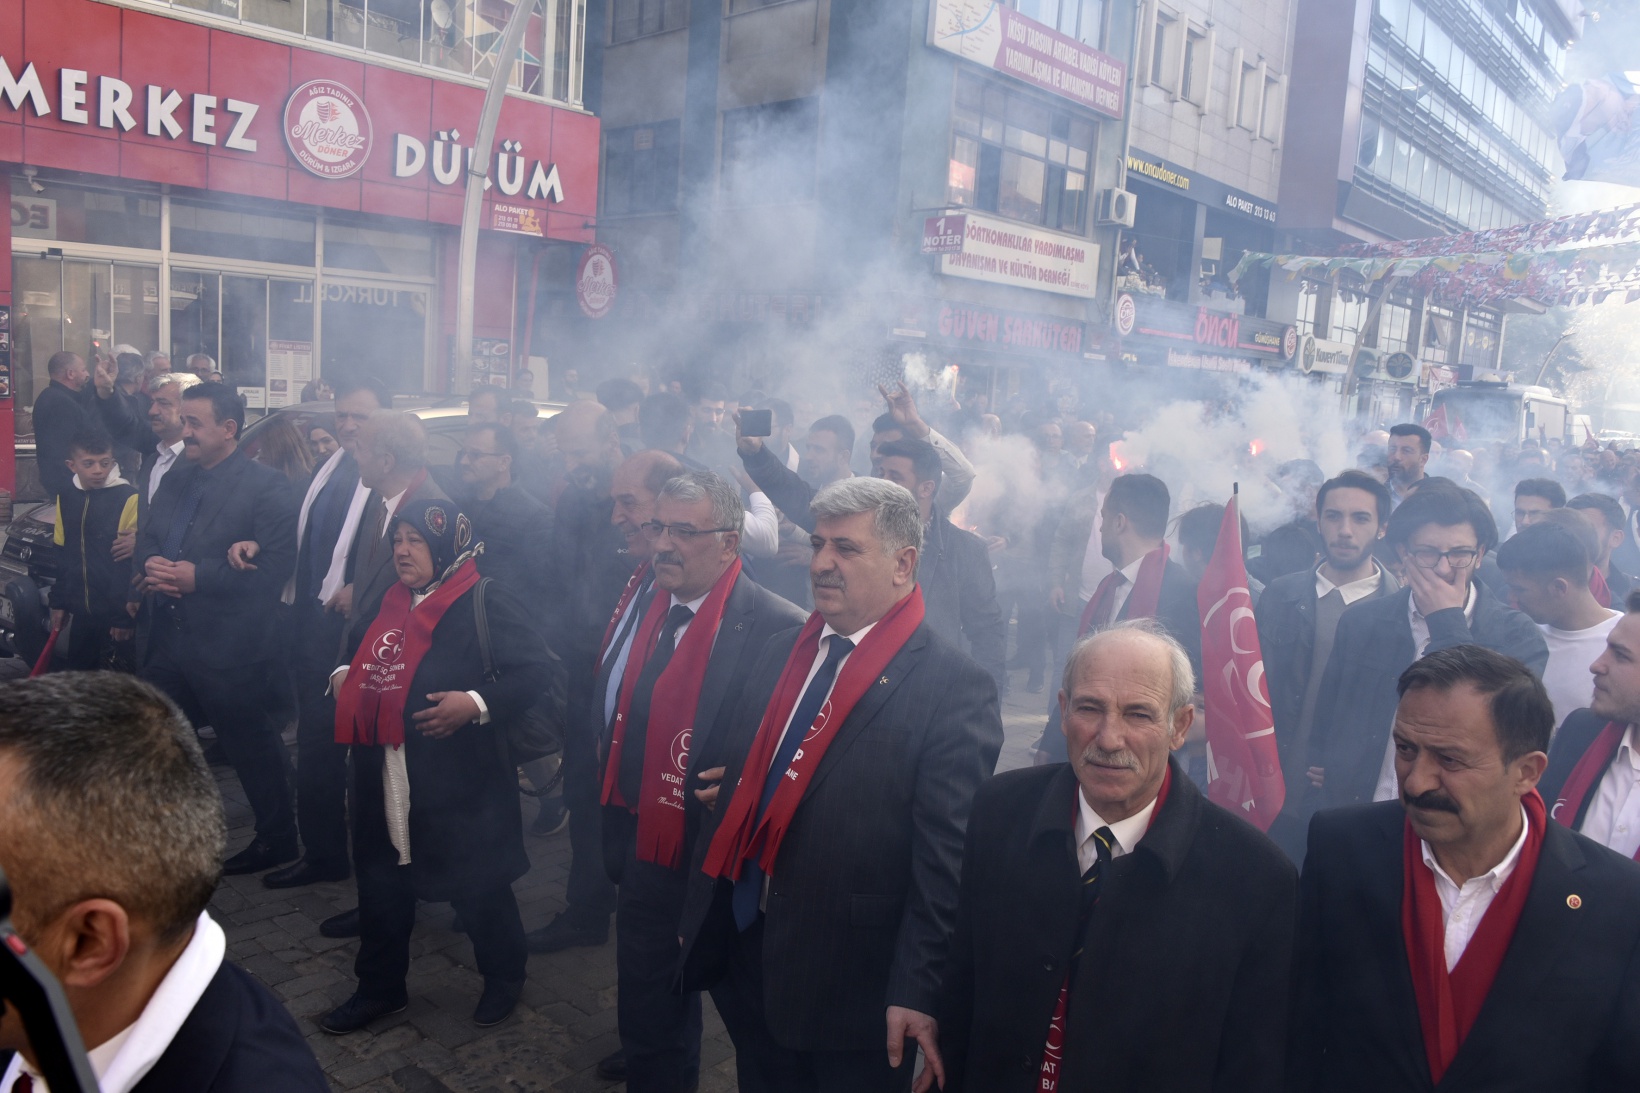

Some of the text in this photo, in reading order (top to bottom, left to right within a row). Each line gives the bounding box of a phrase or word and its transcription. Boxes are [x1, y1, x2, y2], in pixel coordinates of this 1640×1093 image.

[1027, 27, 1053, 57] TARSUN
[1053, 40, 1079, 68] ARTABEL
[1006, 47, 1051, 84] YARDIMLAŞMA
[1052, 67, 1060, 88] VE
[1061, 72, 1094, 101] DAYANIŞMA
[0, 55, 259, 152] MERKEZ
[308, 86, 354, 108] AĞIZ TADINIZ
[291, 120, 366, 150] Merkez
[300, 150, 324, 172] DÜRÜM
[331, 160, 356, 173] IZGARA
[317, 144, 348, 157] DÖNER
[1128, 156, 1190, 190] www.oncudoner.com
[494, 204, 528, 215] ALO PAKET
[1226, 194, 1238, 208] ALO
[1238, 198, 1254, 214] PAKET
[1255, 206, 1263, 218] 213
[1263, 208, 1270, 219] 13
[936, 217, 952, 235] 1.
[924, 234, 962, 247] NOTER
[1034, 239, 1085, 265] YARDIMLAŞMA
[949, 252, 1071, 287] DAYANIŞMA VE KÜLTÜR DERNEĞİ
[577, 276, 617, 301] Merkez
[938, 306, 999, 343] GÜVEN
[1255, 332, 1280, 346] GÜMÜŞHANE
[661, 772, 684, 786] VEDAT
[1041, 1061, 1056, 1074] AT
